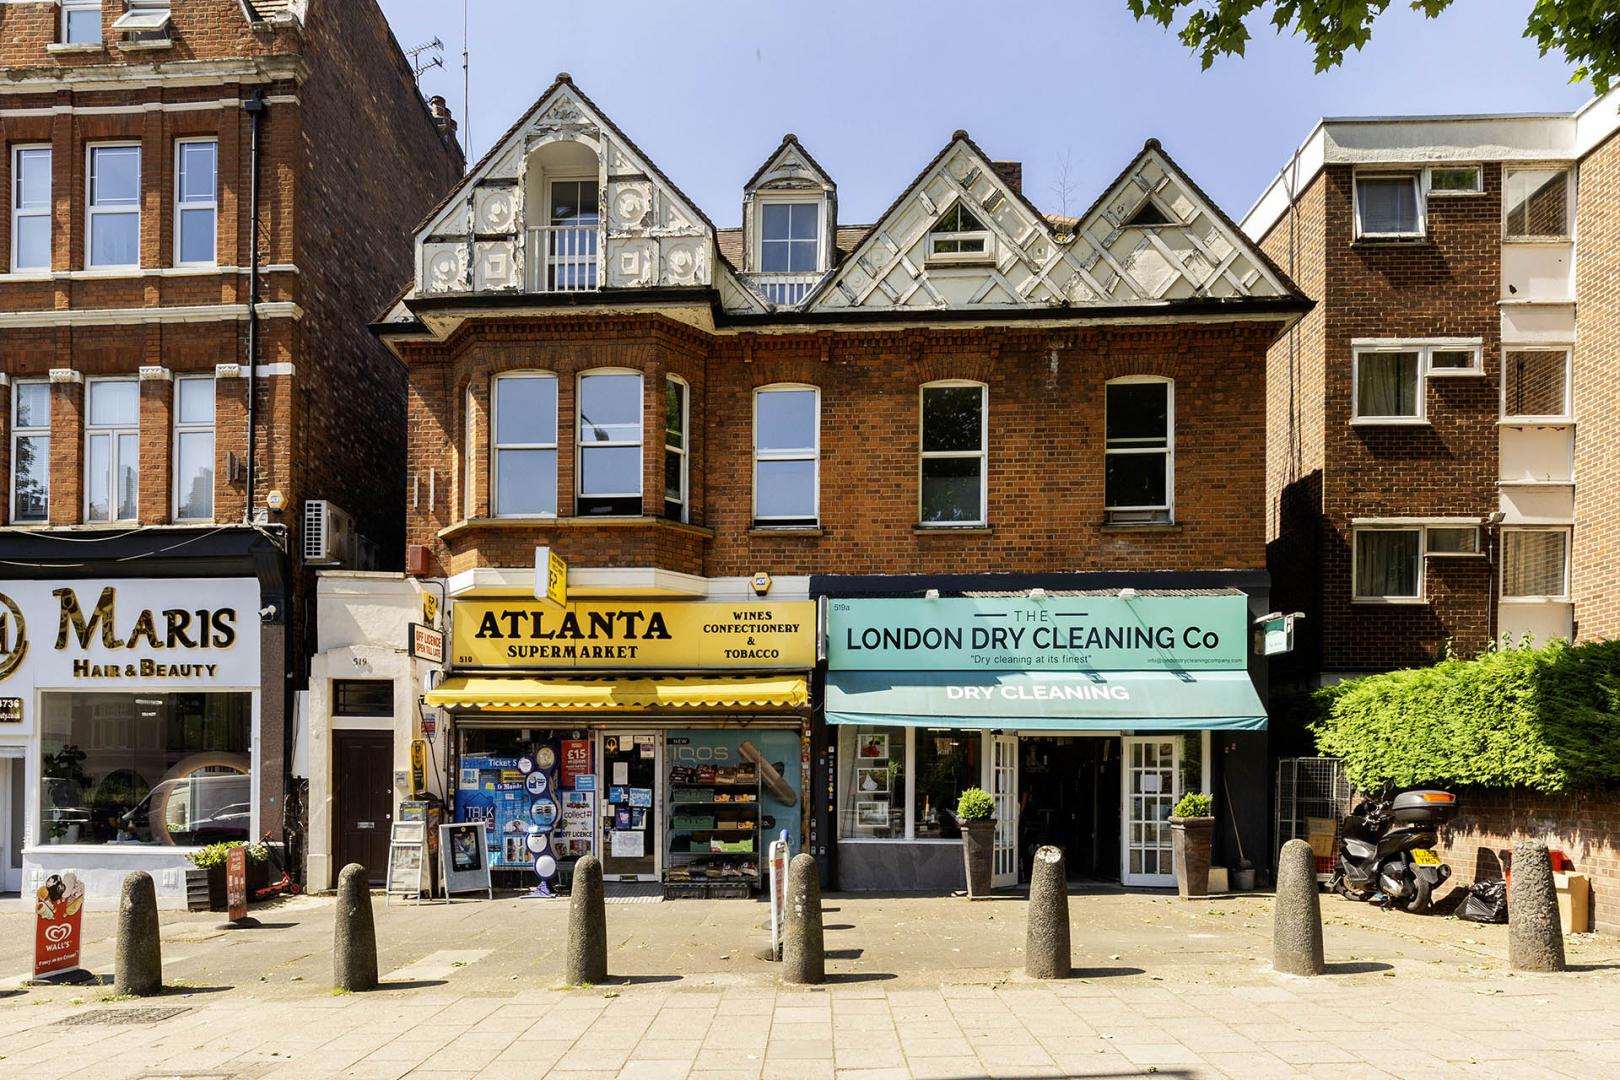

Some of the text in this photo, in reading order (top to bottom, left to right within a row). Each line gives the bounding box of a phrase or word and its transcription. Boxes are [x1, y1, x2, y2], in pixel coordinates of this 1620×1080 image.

[52, 587, 237, 650] MARIS
[733, 611, 772, 621] WINES
[1014, 611, 1048, 622] THE
[475, 610, 672, 640] ATLANTA
[703, 624, 800, 633] CONFECTIONERY
[416, 630, 424, 642] OFF
[747, 637, 755, 646] &
[847, 626, 1219, 650] LONDON DRY CLEANING Co
[507, 645, 638, 658] SUPERMARKET
[724, 649, 779, 659] TOBACCO
[353, 658, 368, 666] 519
[994, 655, 1032, 665] cleaning
[1035, 656, 1044, 664] at
[1047, 655, 1058, 664] its
[73, 658, 217, 678] HAIR & BEAUTY
[946, 685, 1130, 701] DRY CLEANING
[567, 749, 587, 760] £15
[673, 746, 729, 761] IQOS
[488, 759, 512, 767] Ticket
[466, 806, 494, 818] TALK
[46, 941, 70, 951] WALL'S
